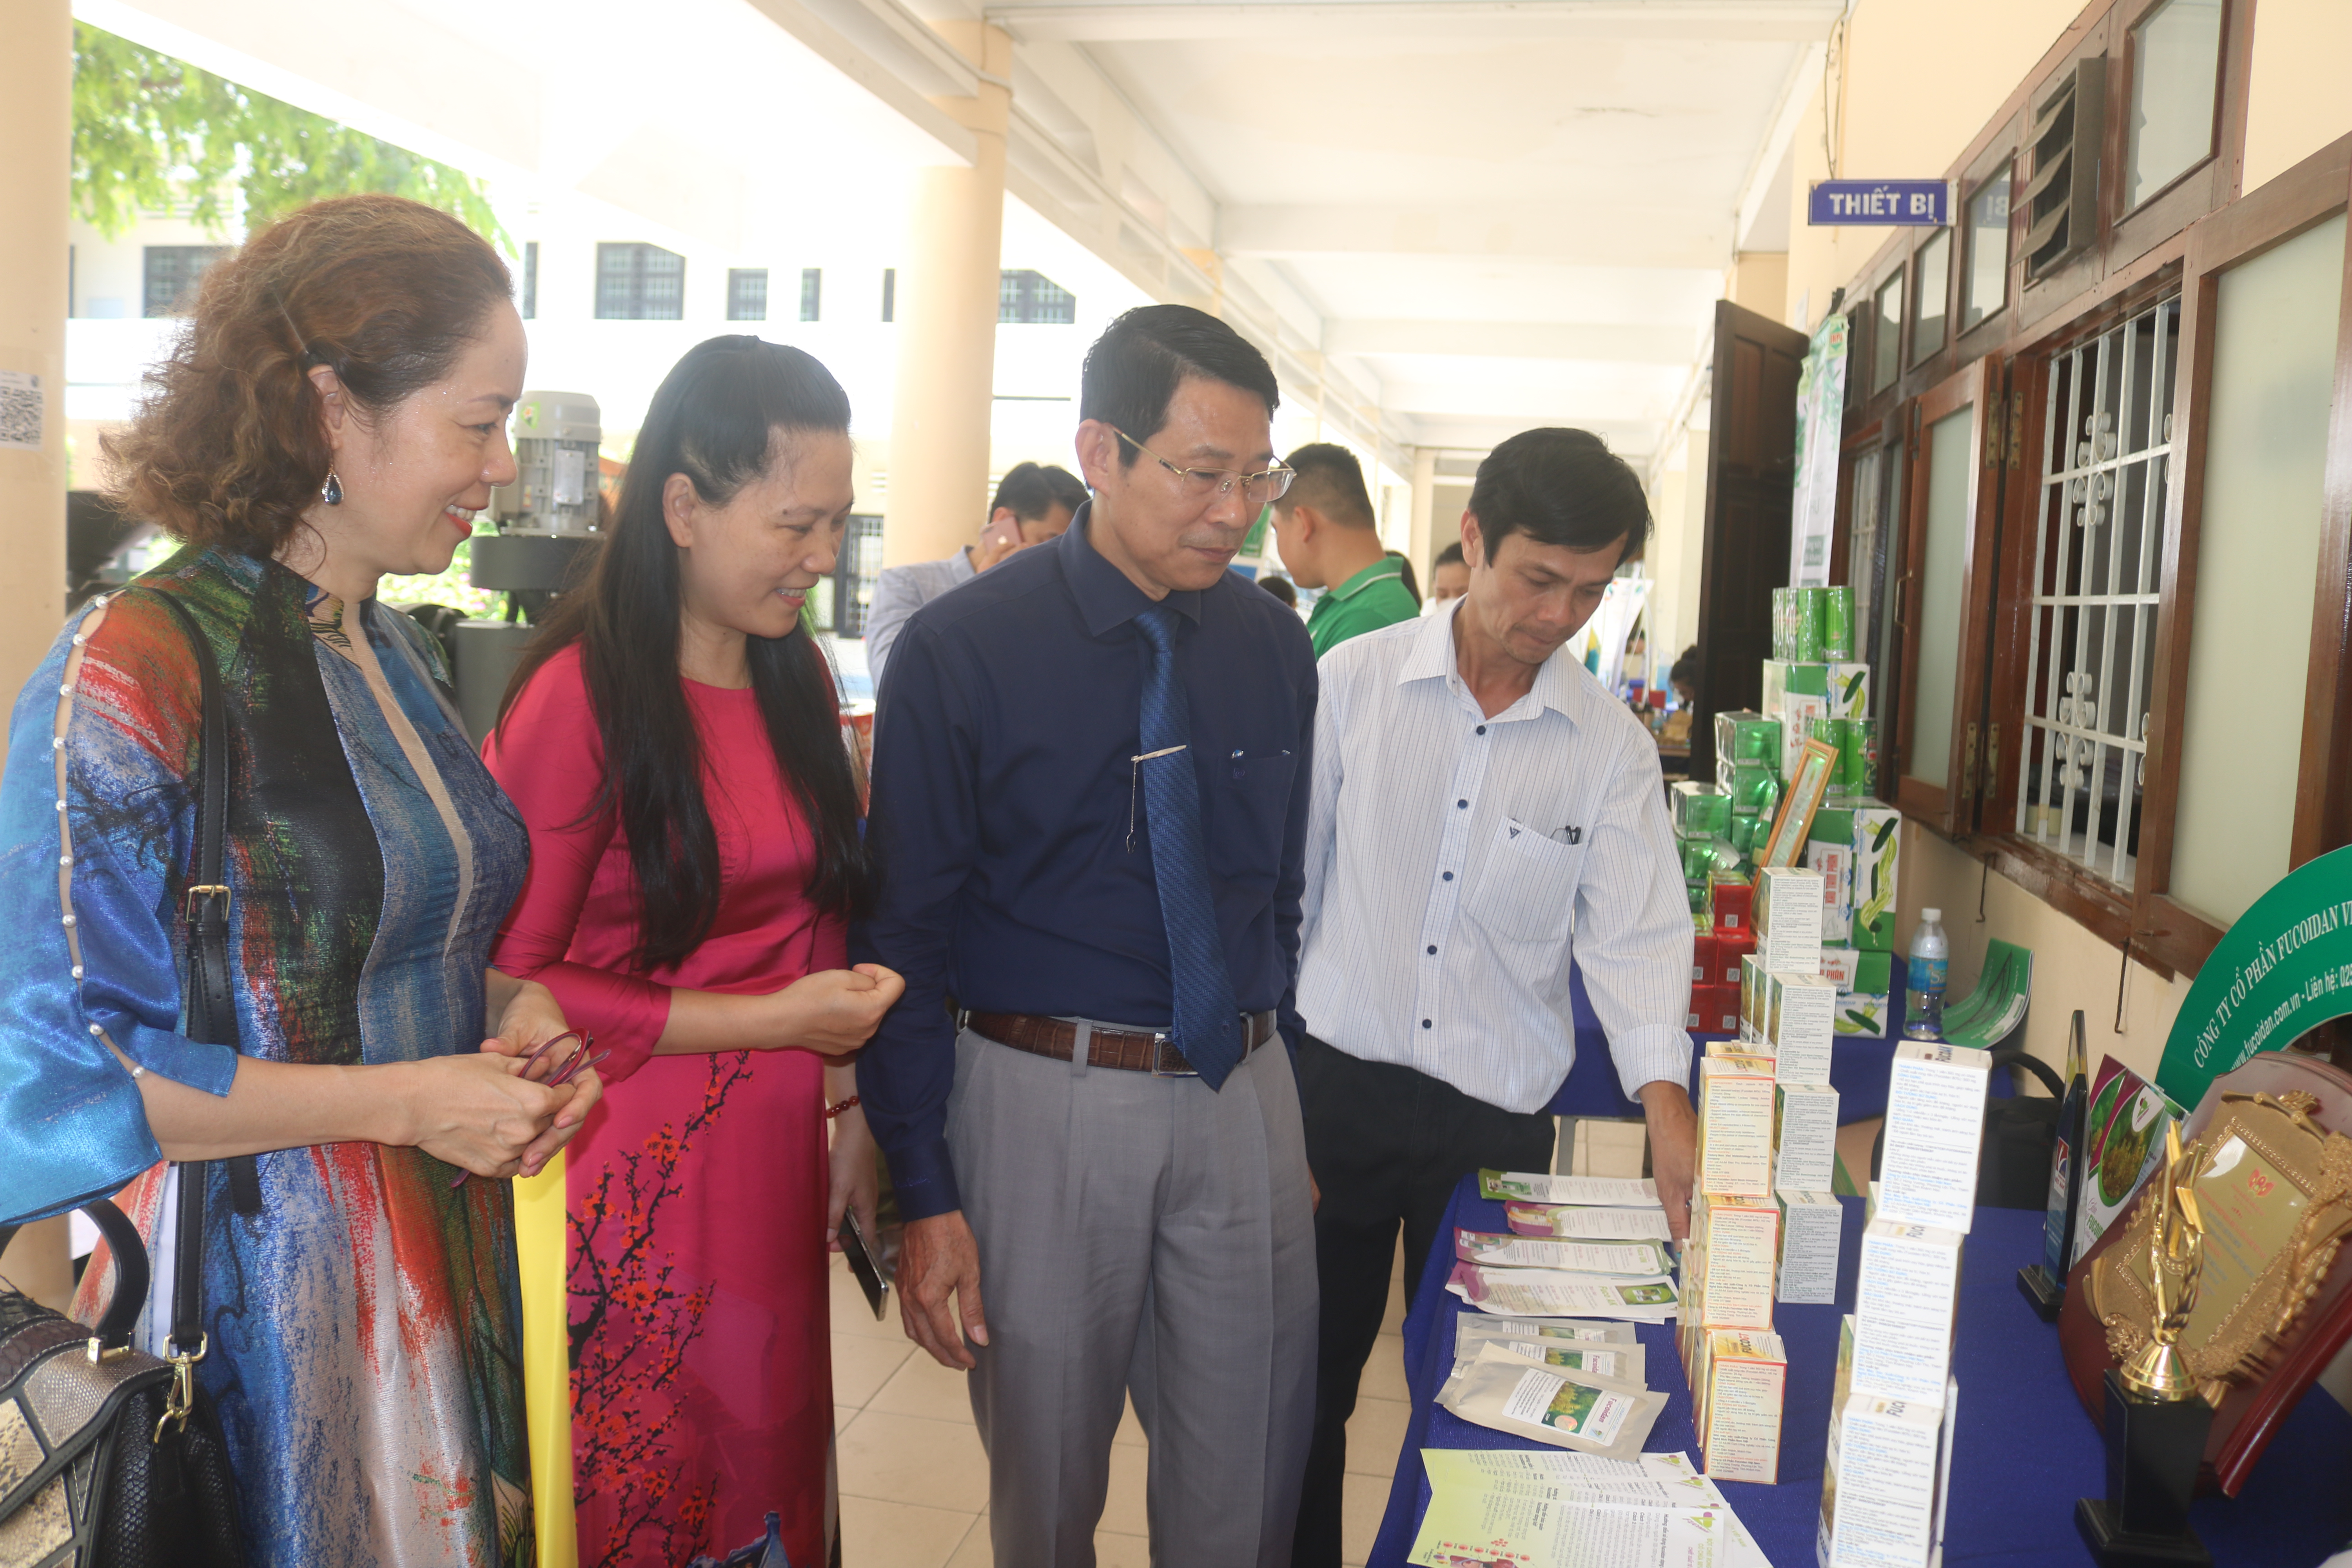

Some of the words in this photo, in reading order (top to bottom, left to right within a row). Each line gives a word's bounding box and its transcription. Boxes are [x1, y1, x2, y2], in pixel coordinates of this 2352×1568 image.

[1829, 185, 1901, 215] THIẾT
[1910, 193, 1935, 220] BỊ
[2193, 1019, 2220, 1069] CÔNG
[2216, 996, 2232, 1027] TY
[2230, 966, 2246, 1008] CỔ
[2244, 941, 2277, 991] PHẦN
[2276, 905, 2338, 961] FUCOIDAN
[2305, 976, 2324, 1002] Liên
[2324, 968, 2339, 995] hệ:
[1599, 1397, 1617, 1423] Fucoidan
